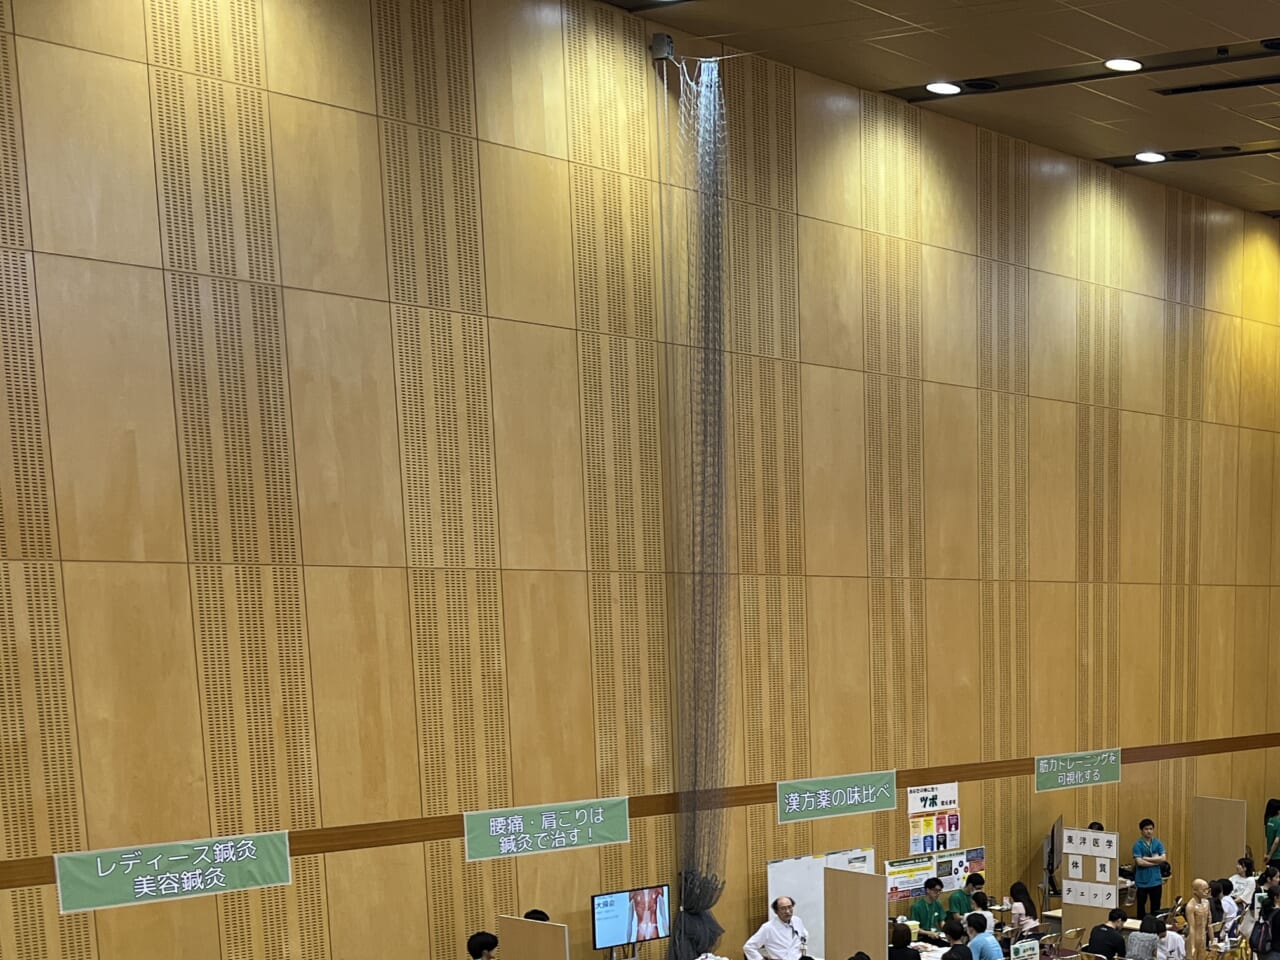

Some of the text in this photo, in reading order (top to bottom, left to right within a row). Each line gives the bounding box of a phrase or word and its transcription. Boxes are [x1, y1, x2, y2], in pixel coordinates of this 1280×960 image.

[1039, 752, 1117, 773] 筋力トレーニングを
[1057, 769, 1101, 785] 可視化する
[784, 783, 891, 813] 漢方薬の味比べ
[920, 794, 938, 808] ツボ
[489, 807, 605, 836] 腰痛・肩こりは
[499, 828, 593, 854] 鍼灸で治す！
[1066, 835, 1113, 849] 東洋医学
[96, 839, 258, 878] レディース鍼灸
[133, 867, 227, 898] 美容鍼灸
[1065, 887, 1112, 900] チェック
